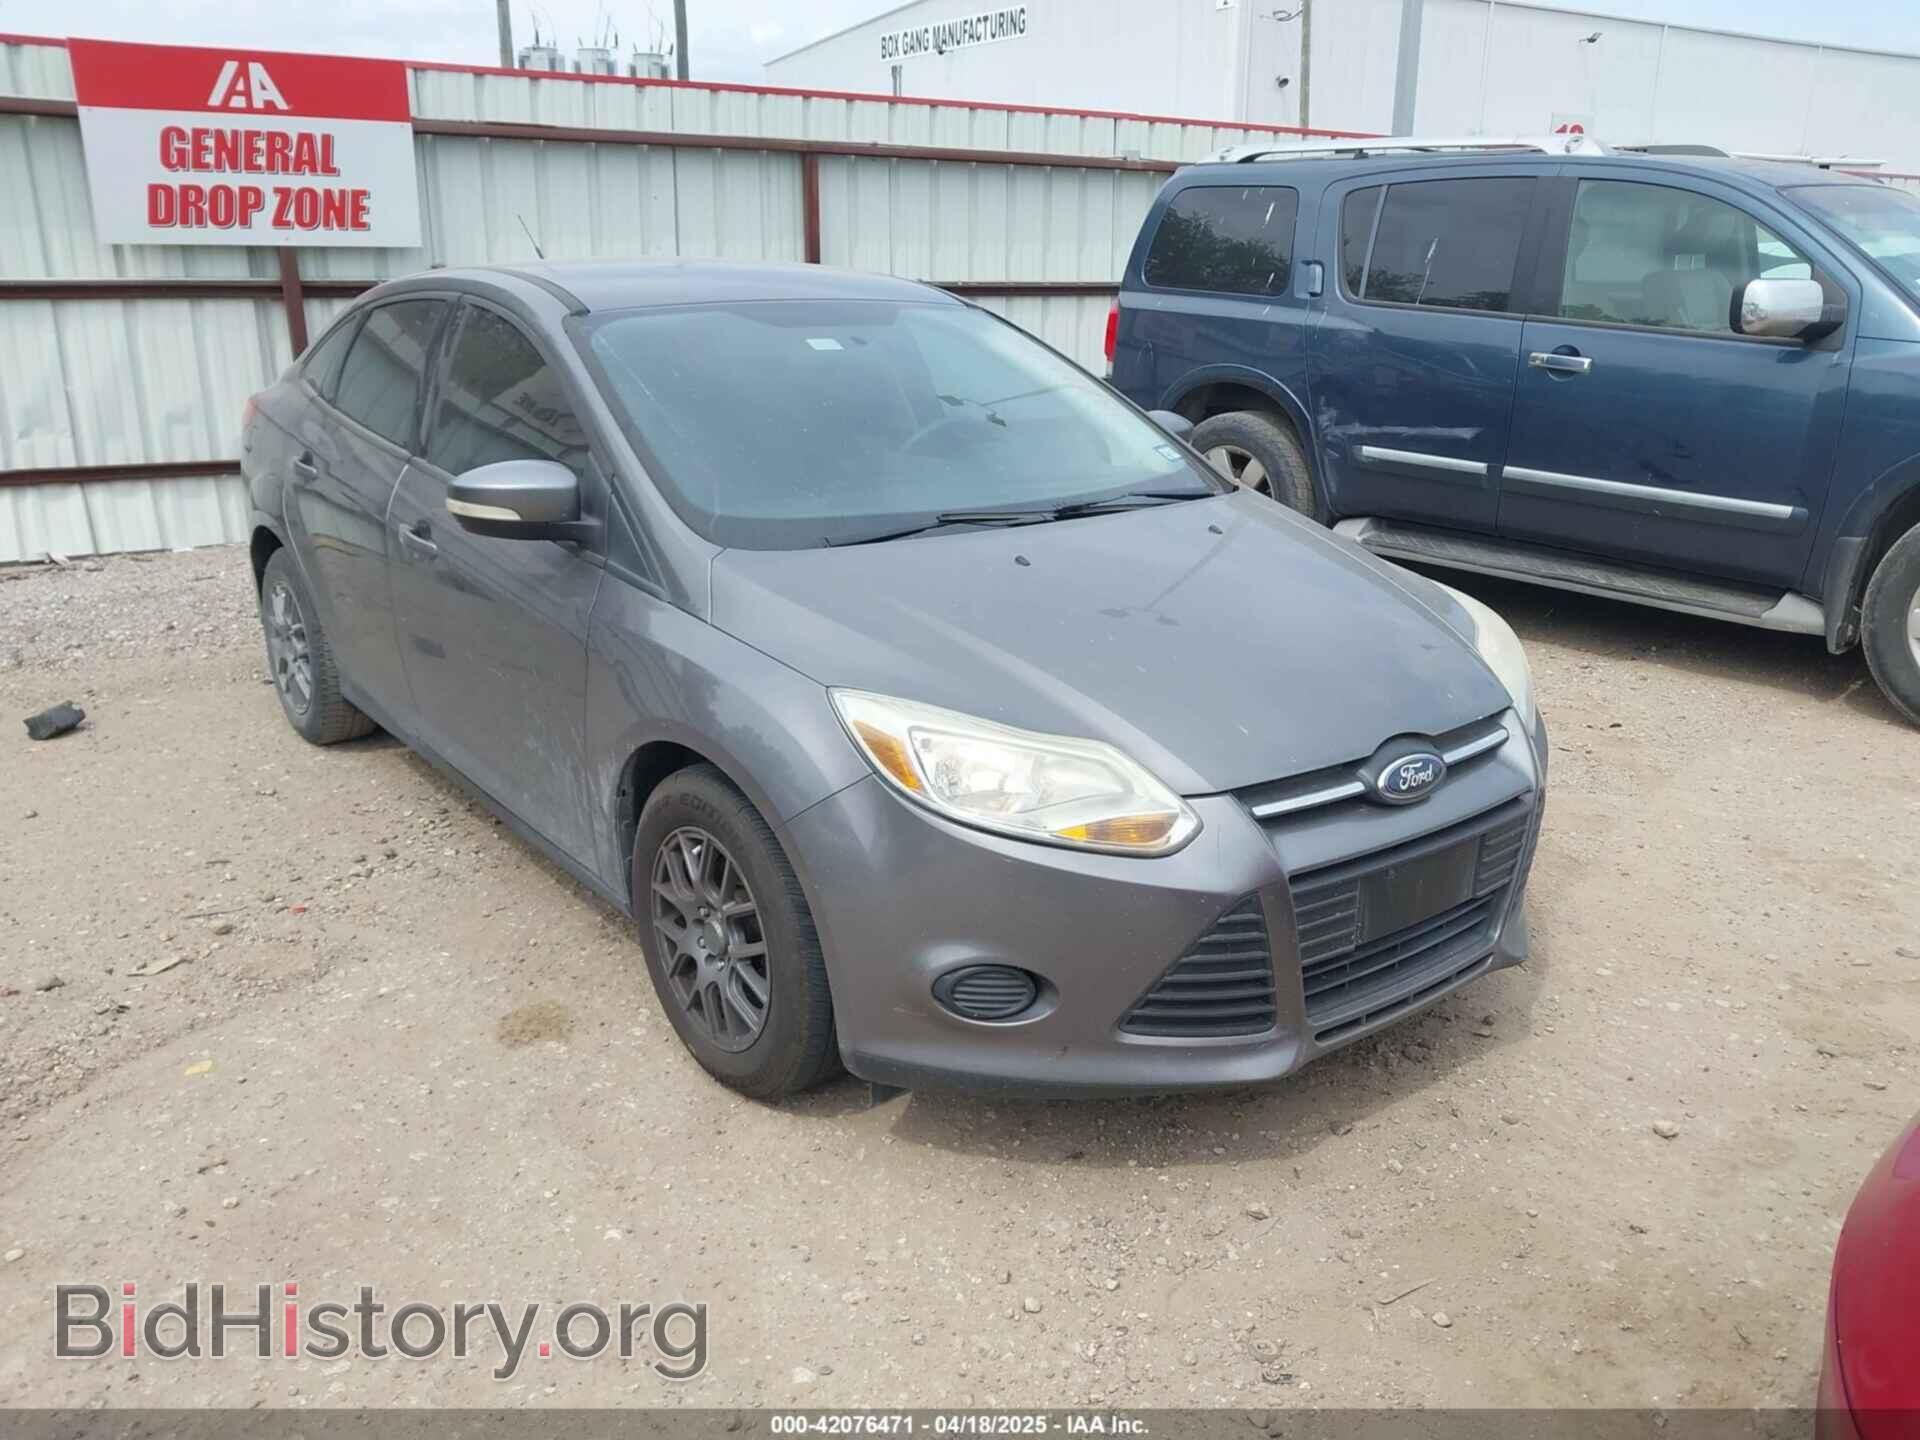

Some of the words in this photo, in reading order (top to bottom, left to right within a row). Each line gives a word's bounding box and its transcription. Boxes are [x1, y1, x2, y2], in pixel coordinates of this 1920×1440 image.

[881, 34, 900, 60] BOX
[902, 28, 929, 55] GANG
[932, 7, 1026, 50] MANUFACTURING
[159, 125, 340, 177] GENERAL
[147, 183, 265, 229] DROP
[271, 185, 371, 232] ZONE
[1399, 761, 1434, 790] Ford
